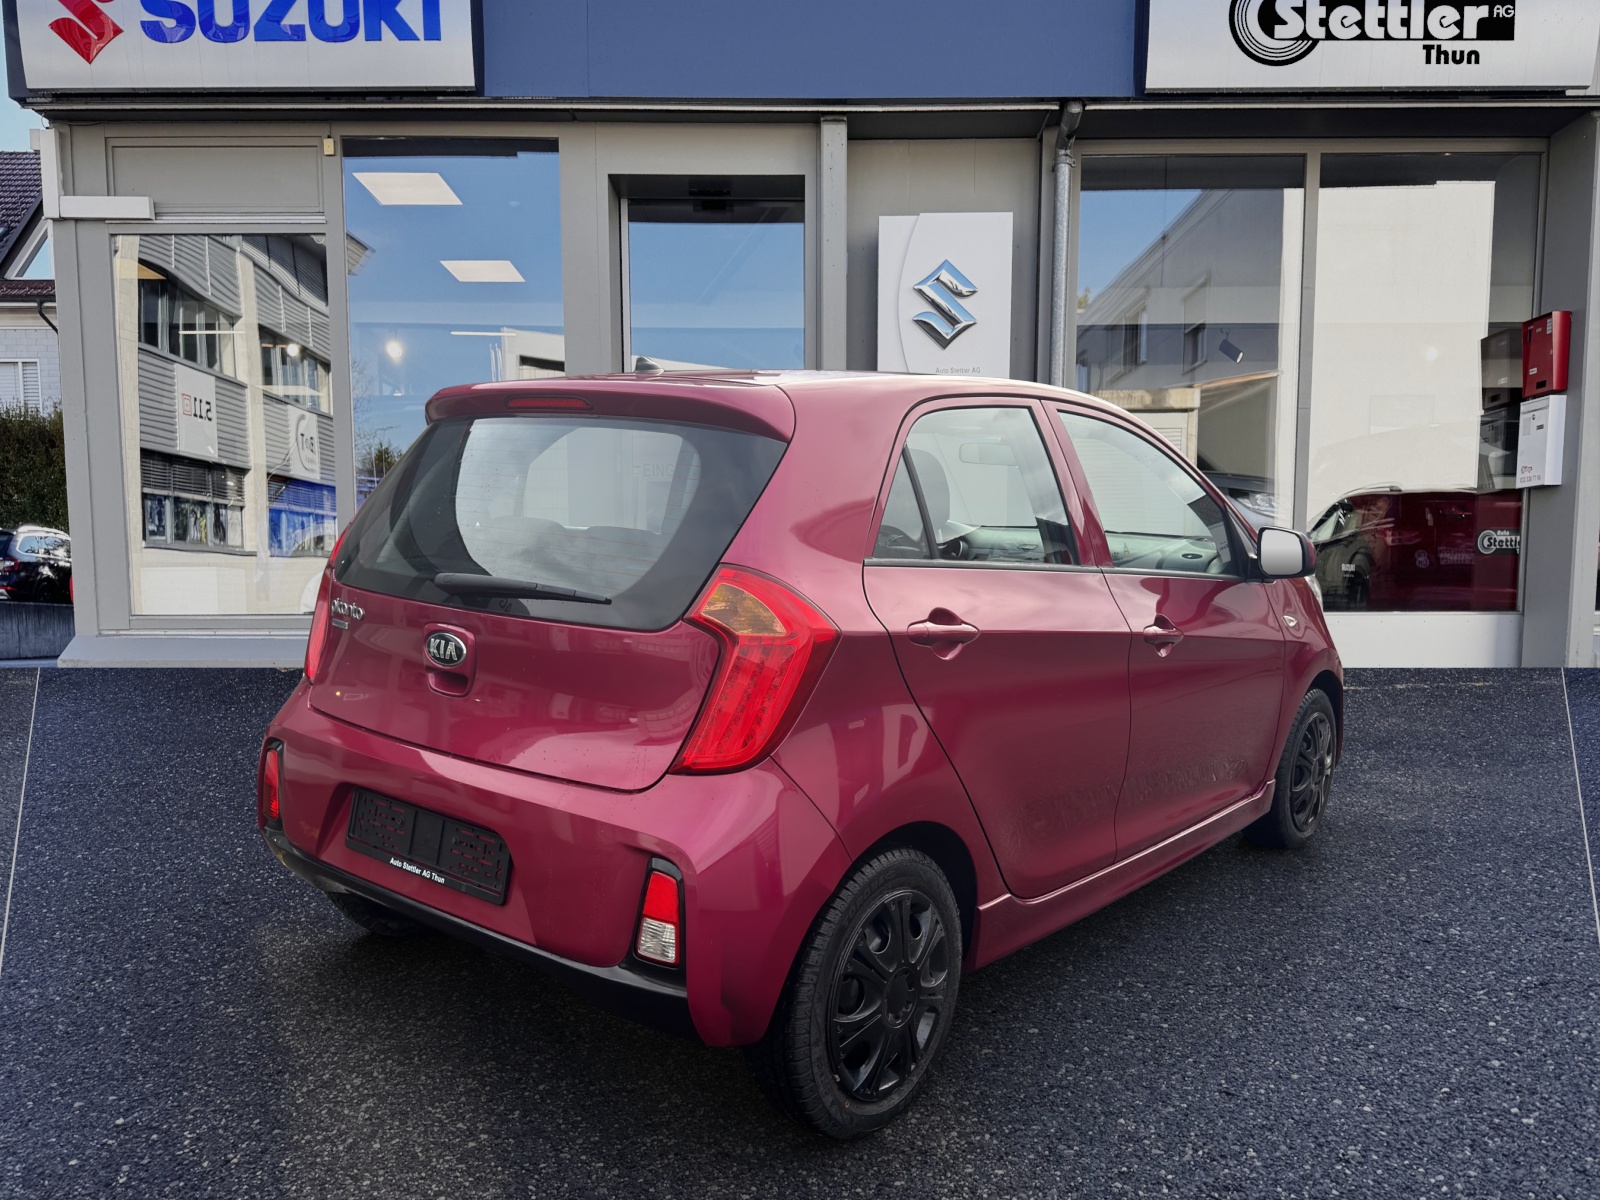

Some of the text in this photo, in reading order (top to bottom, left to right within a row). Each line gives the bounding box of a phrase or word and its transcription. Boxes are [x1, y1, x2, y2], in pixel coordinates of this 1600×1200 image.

[140, 0, 441, 43] SUZUKI
[1273, 0, 1515, 40] Stettler AG
[1422, 44, 1480, 65] Thun
[935, 366, 981, 374] Auto Stettler AG
[429, 638, 458, 661] KIA
[389, 857, 445, 884] Auto Stettler AG Thun
